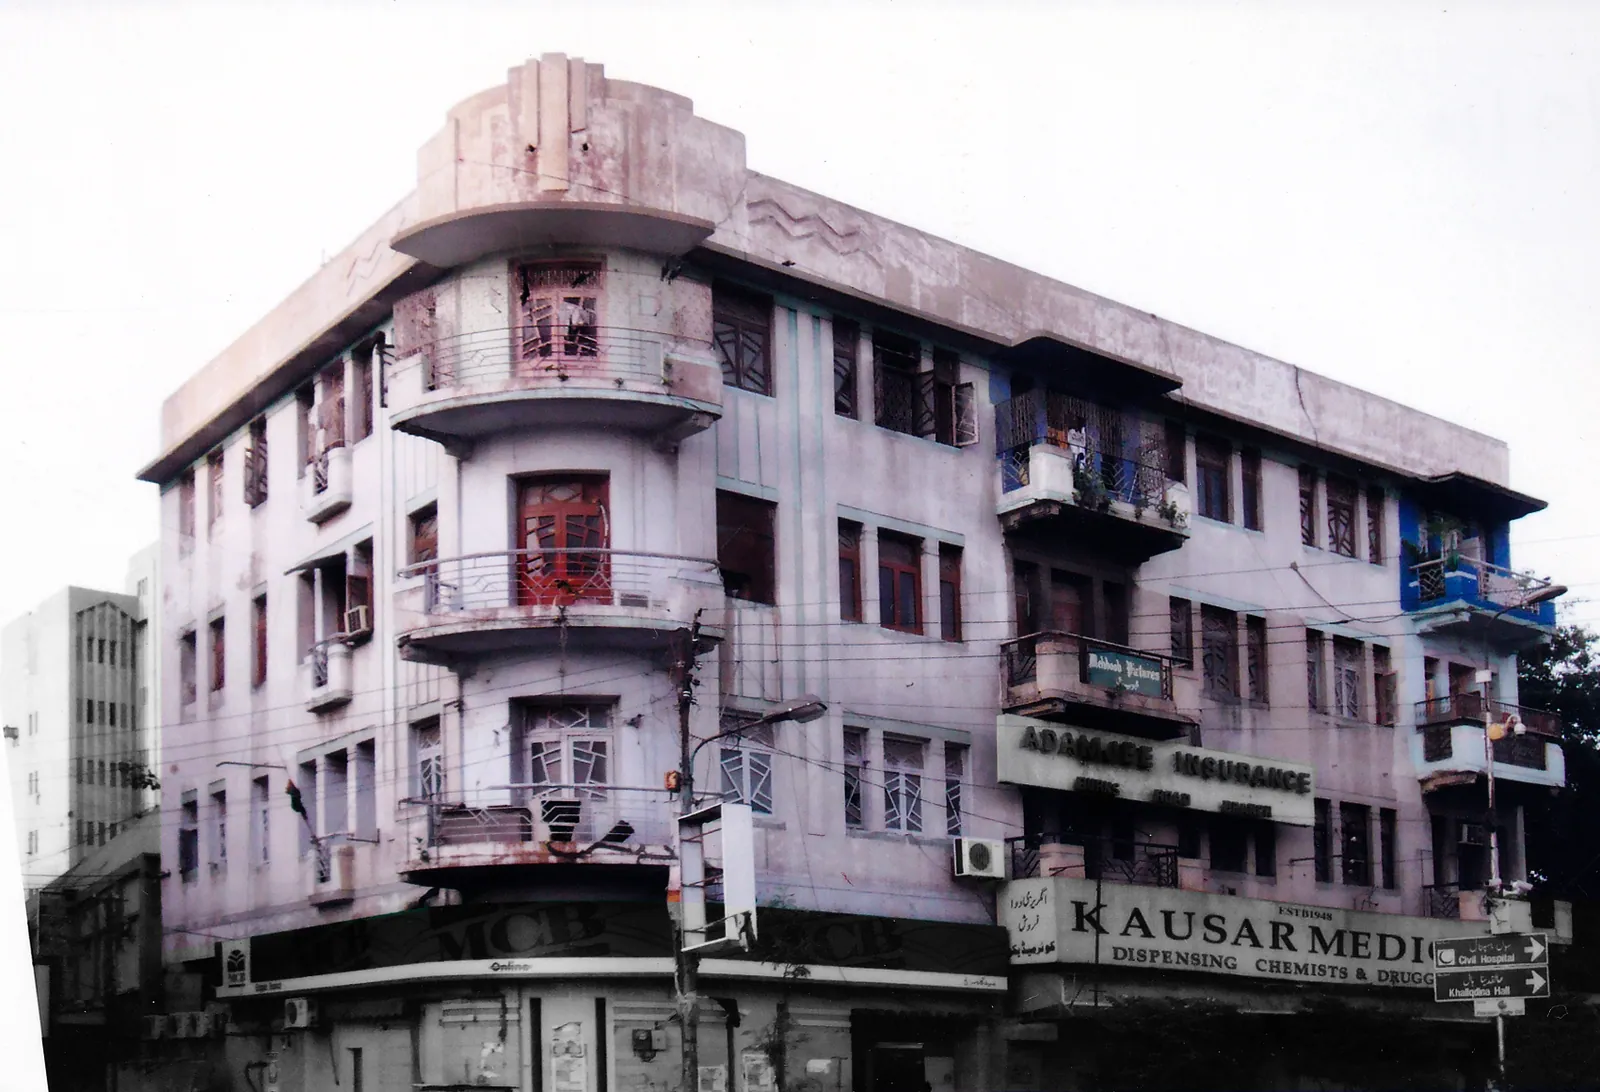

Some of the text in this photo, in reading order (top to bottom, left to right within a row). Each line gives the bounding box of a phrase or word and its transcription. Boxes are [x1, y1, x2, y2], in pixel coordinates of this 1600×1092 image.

[1173, 751, 1311, 795] INSURANCE
[1018, 914, 1040, 932] فروش
[1070, 900, 1298, 952] KAUSAR
[490, 960, 532, 972] Online
[1112, 946, 1238, 970] DISPENSING
[1255, 958, 1348, 980] CHEMISTS
[1355, 967, 1368, 981] &
[1458, 953, 1515, 966] Civil Hospital
[1448, 986, 1511, 998] Khaliqdina Hall
